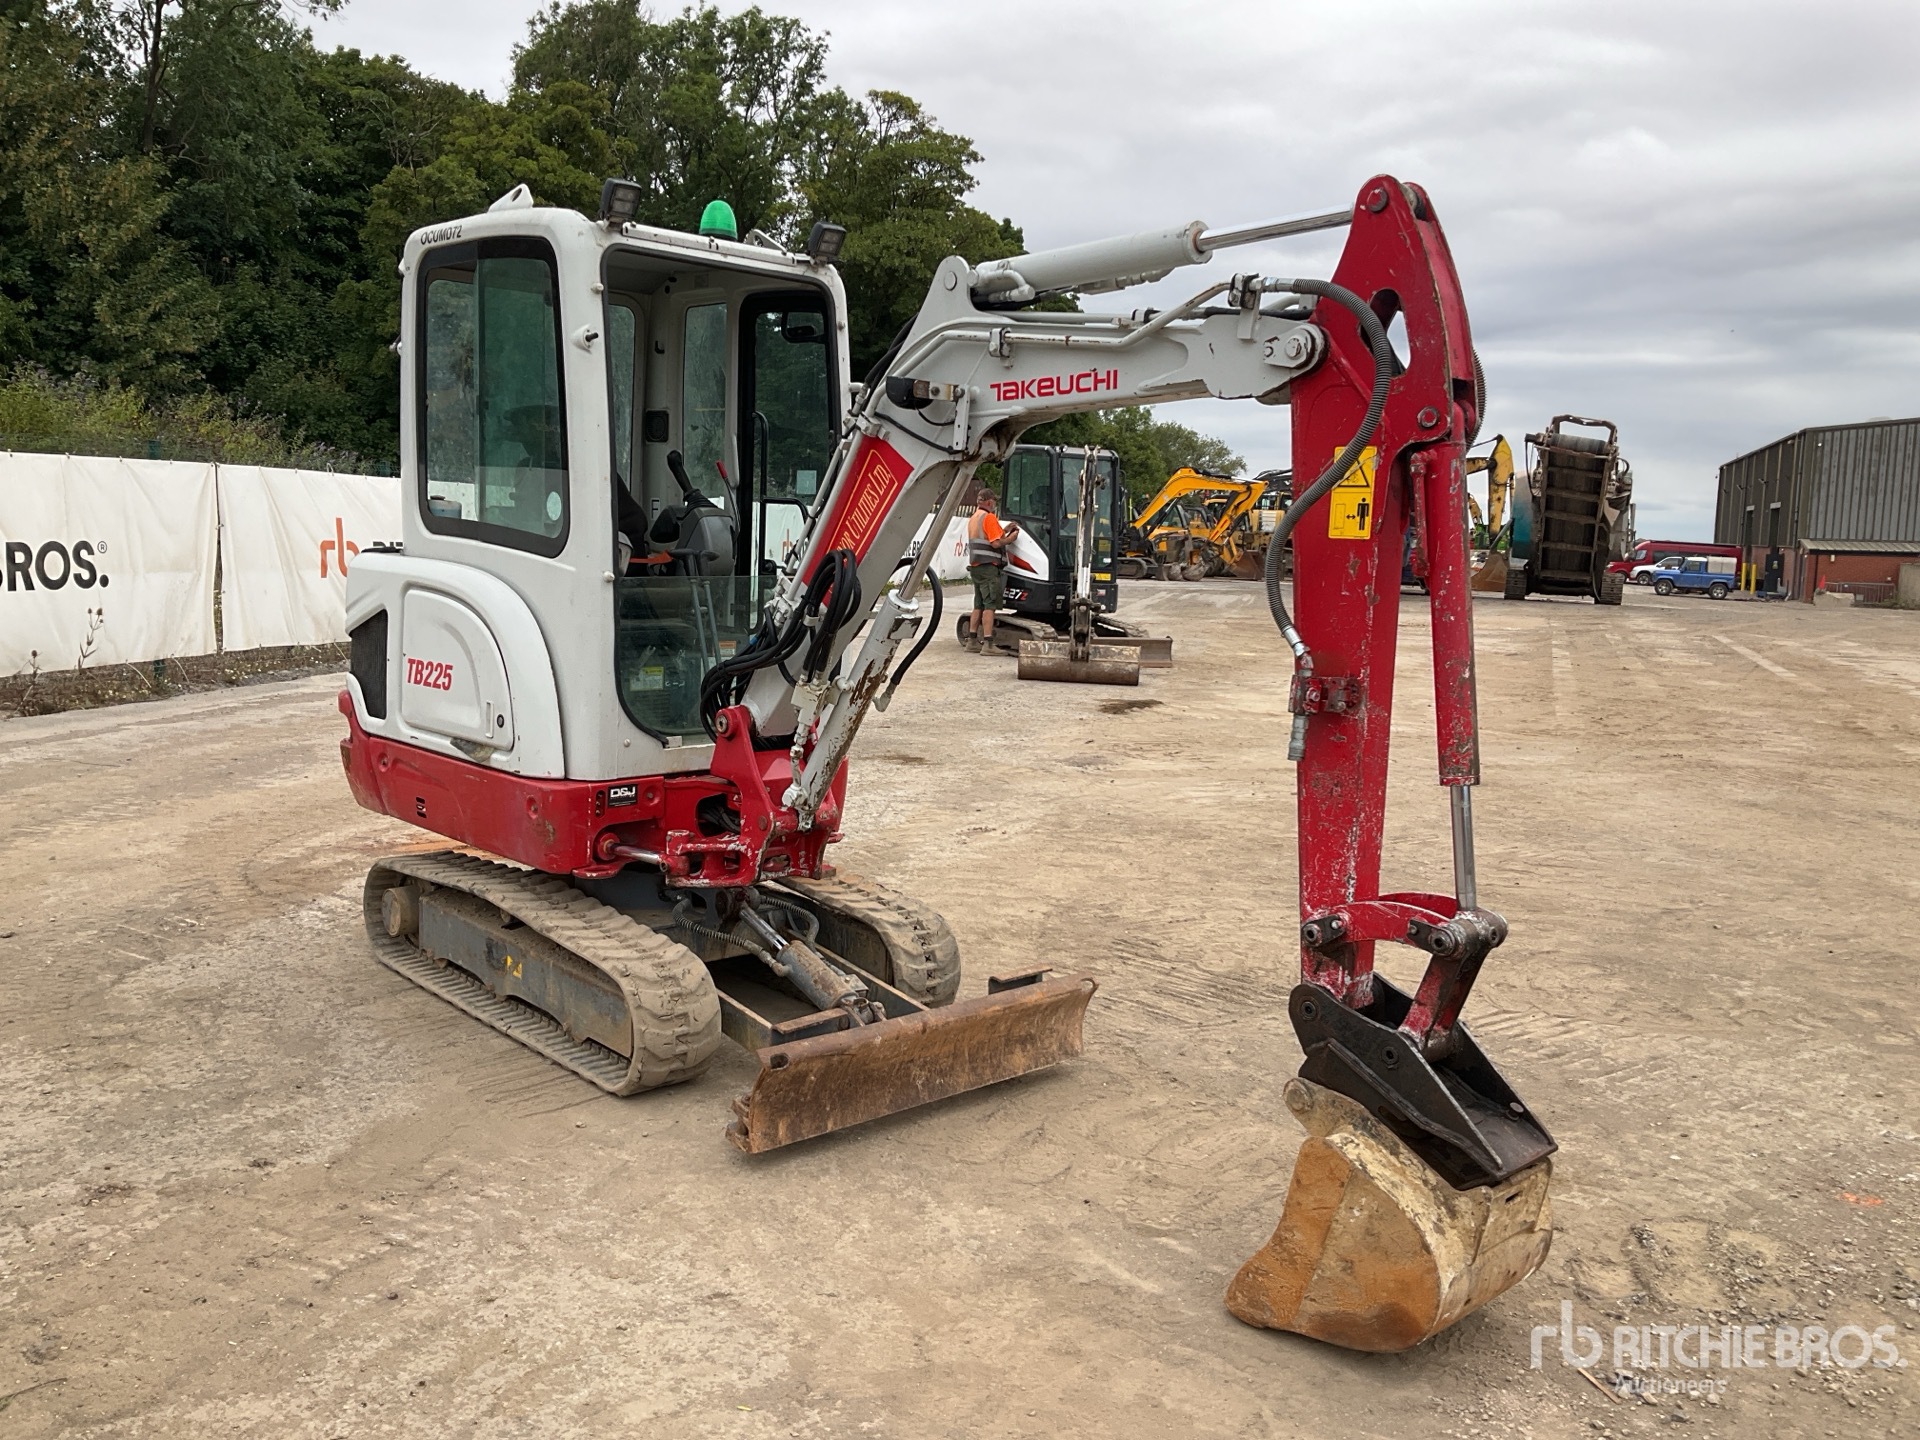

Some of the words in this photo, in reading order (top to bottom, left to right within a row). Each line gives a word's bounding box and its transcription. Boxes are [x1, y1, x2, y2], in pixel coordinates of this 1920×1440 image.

[846, 484, 880, 539] UTILITIES
[408, 658, 453, 690] TB225
[610, 786, 636, 798] D&J
